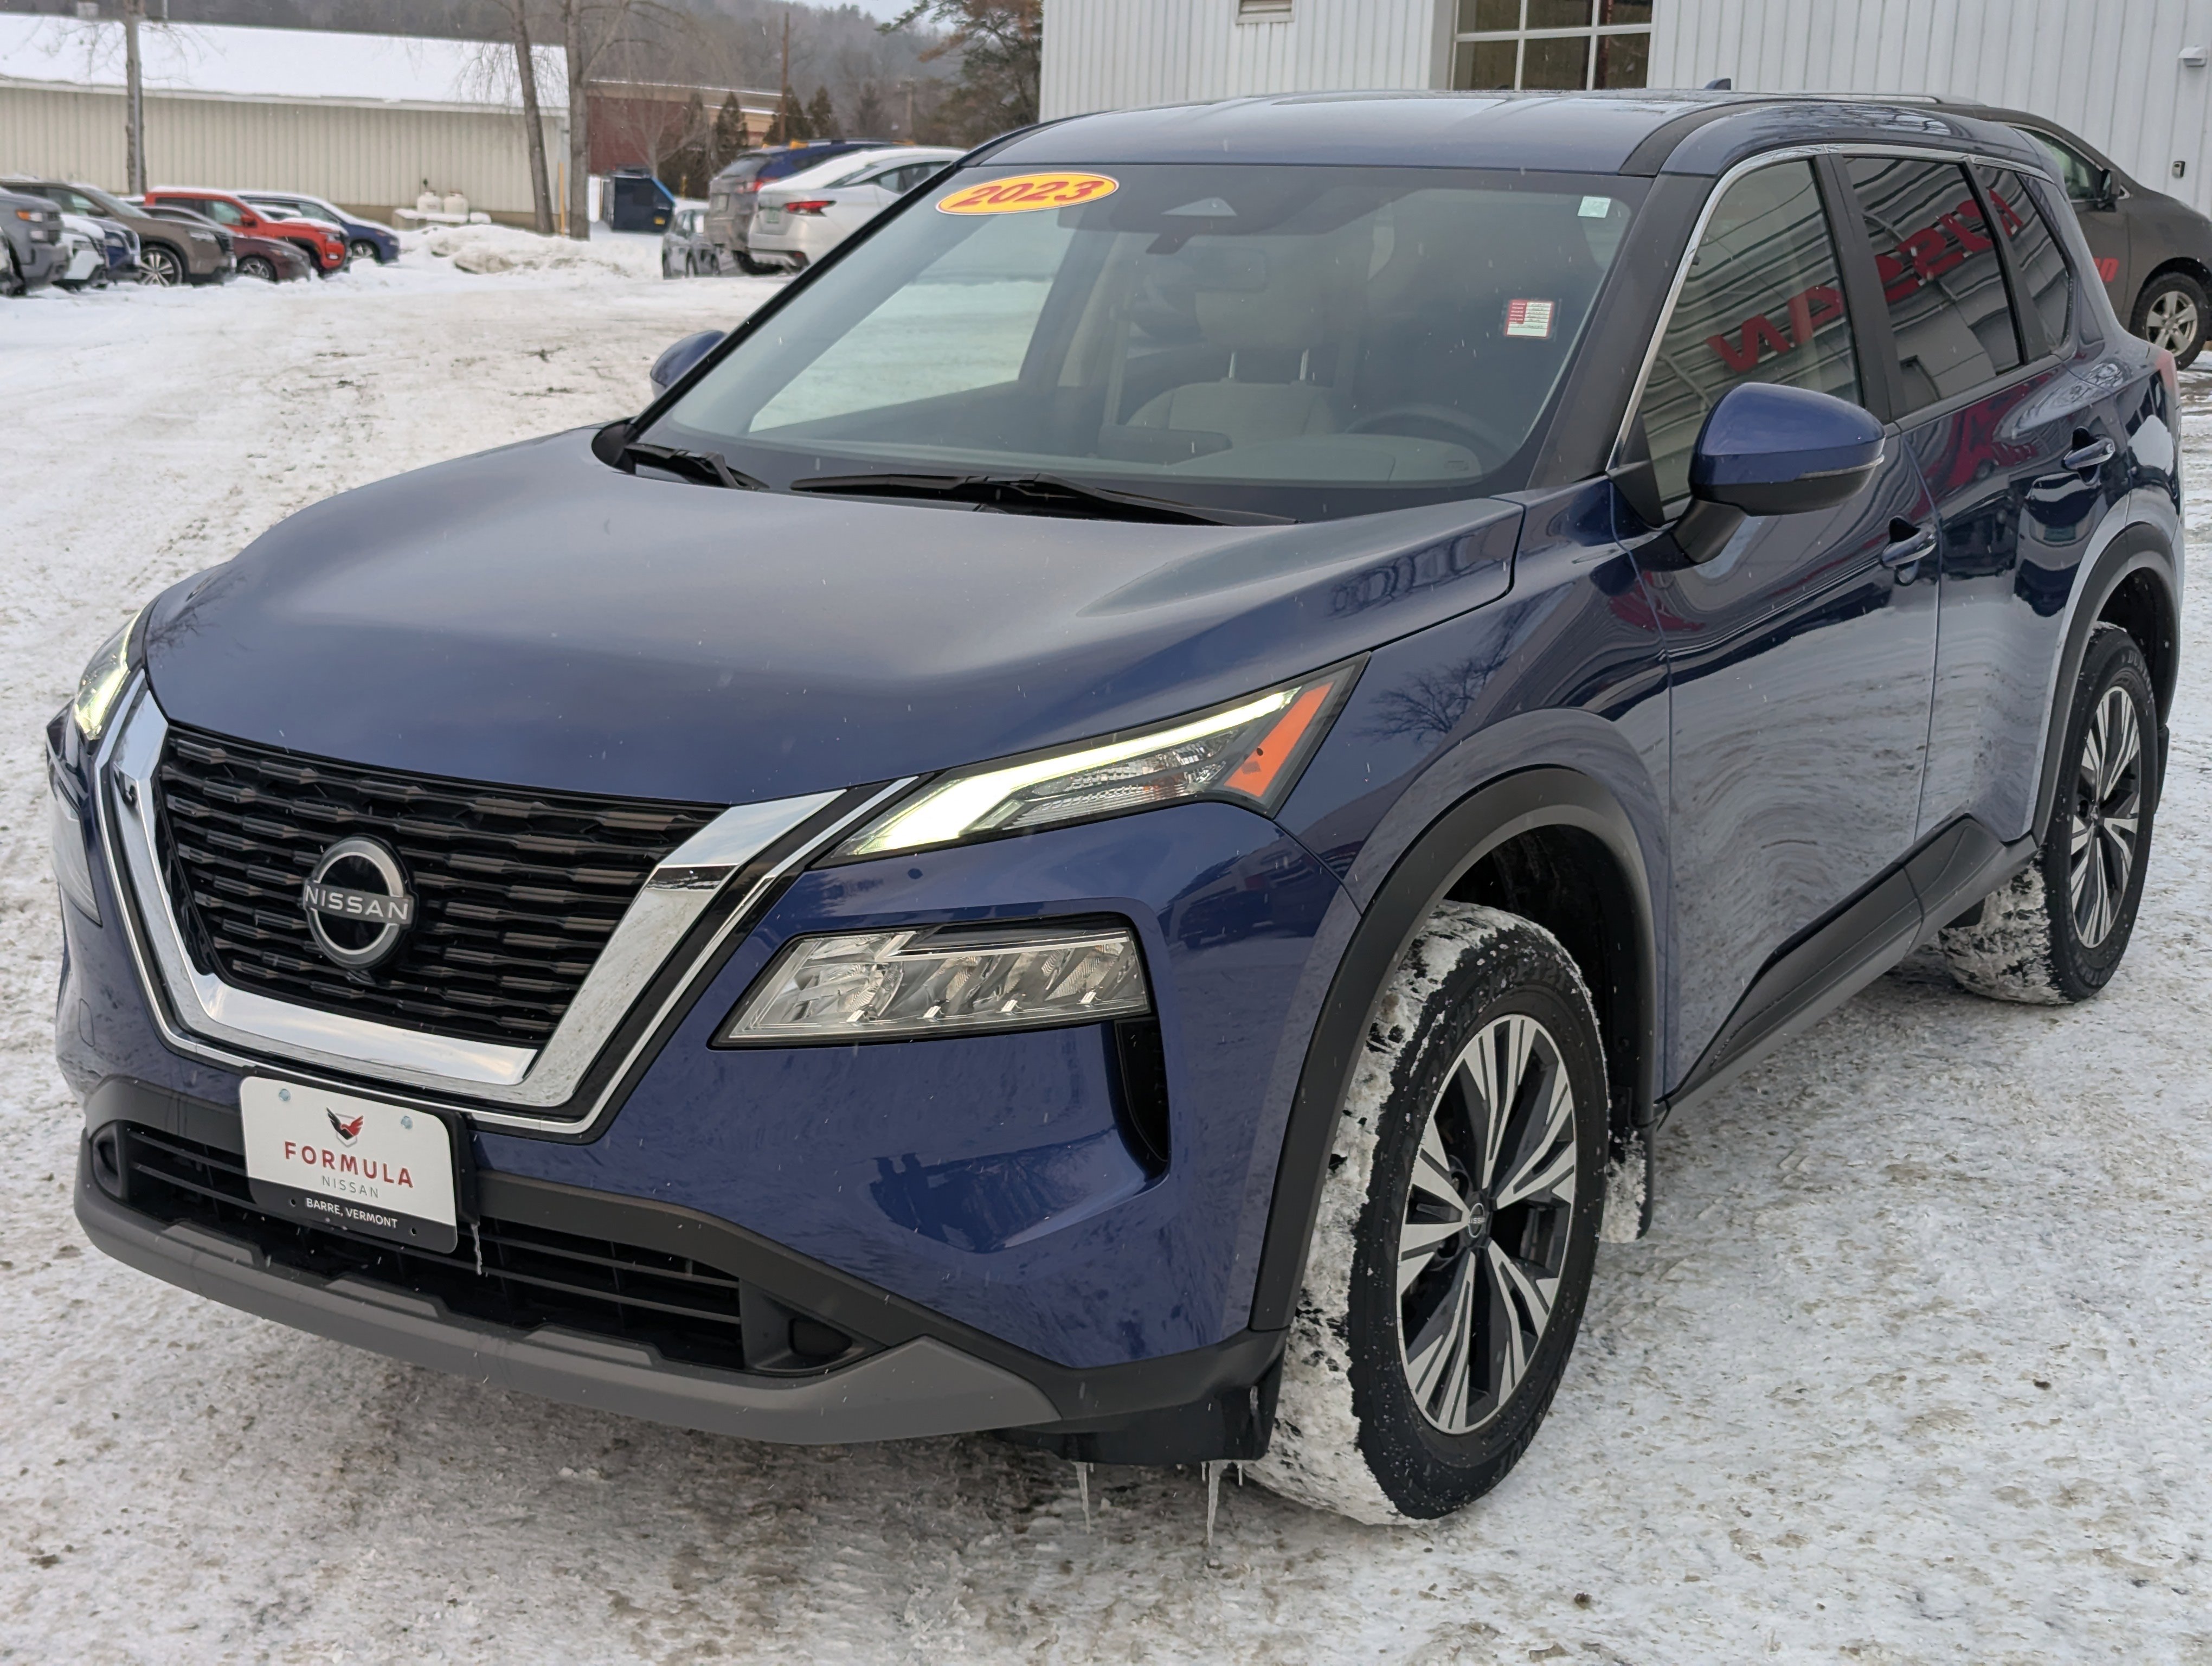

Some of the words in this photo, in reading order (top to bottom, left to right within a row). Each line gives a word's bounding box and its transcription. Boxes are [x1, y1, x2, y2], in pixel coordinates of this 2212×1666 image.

[948, 180, 1105, 209] 2023
[305, 885, 408, 920] NISSAN
[284, 1140, 414, 1188] FORMULA
[321, 1175, 379, 1199] NISSAN
[305, 1197, 344, 1217] BARRE,
[346, 1208, 399, 1229] VERMONT
